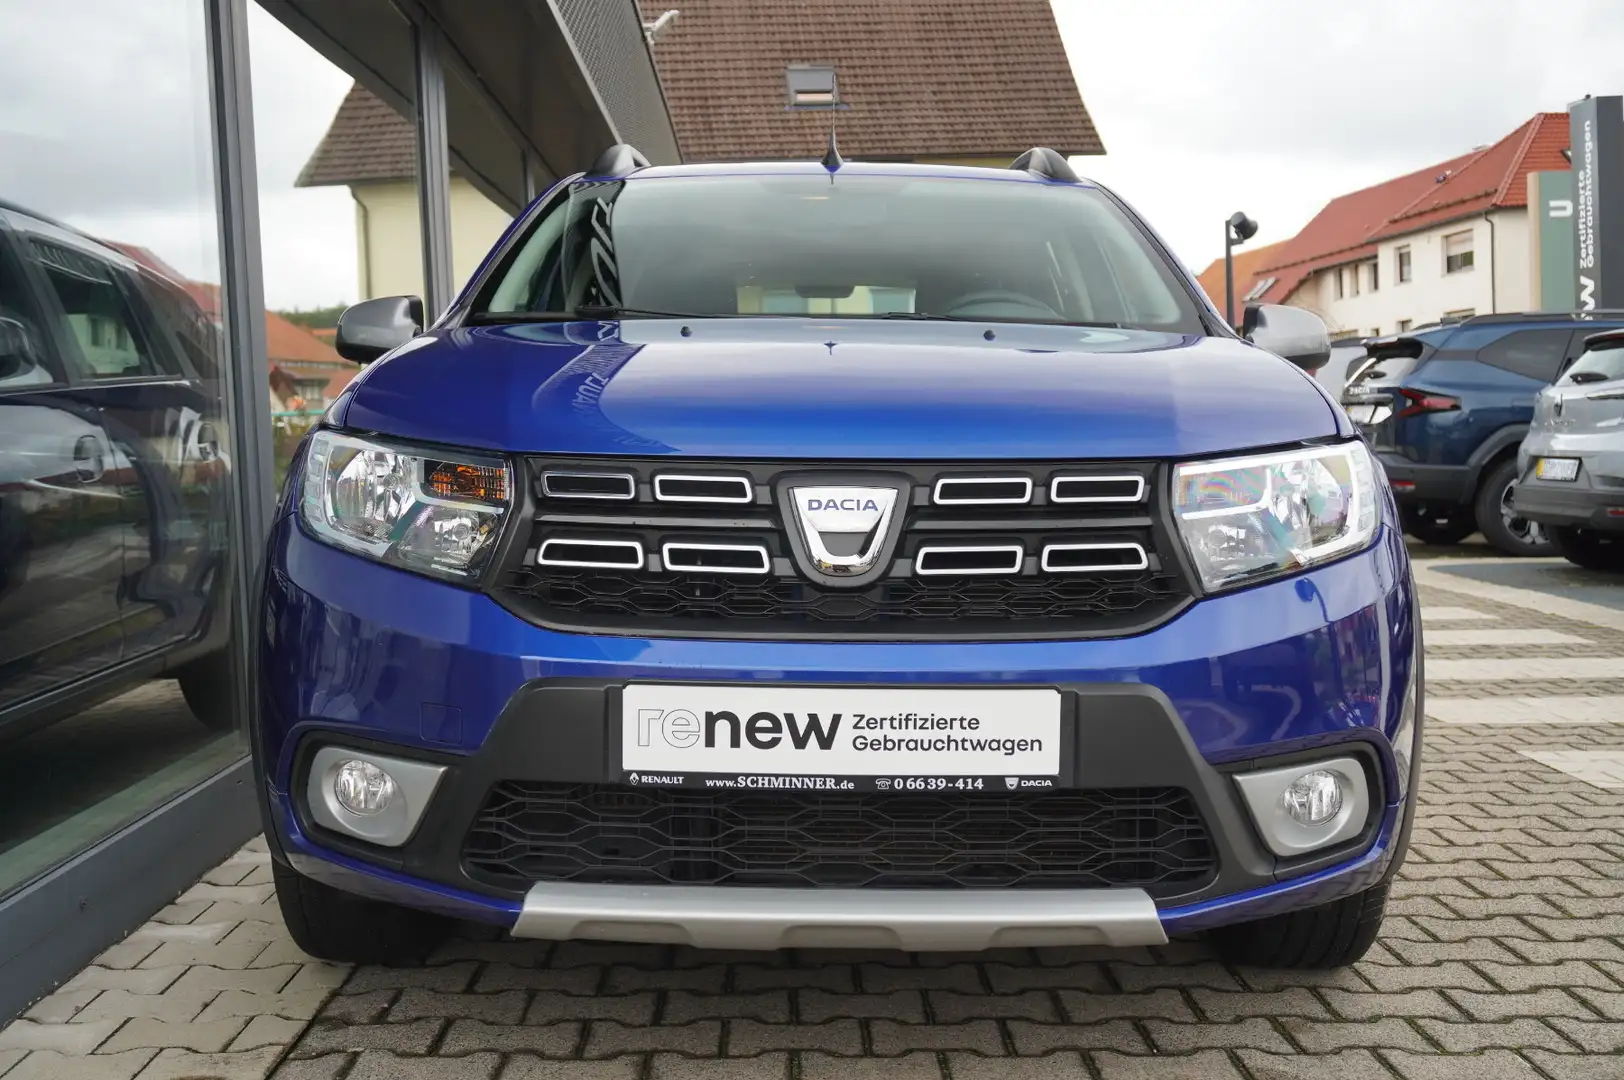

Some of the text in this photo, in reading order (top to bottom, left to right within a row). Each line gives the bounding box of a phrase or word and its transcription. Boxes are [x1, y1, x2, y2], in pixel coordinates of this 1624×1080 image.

[1584, 120, 1594, 268] Gebrauchtwagen
[1578, 170, 1587, 269] Zertifizierte
[807, 499, 878, 511] DACIA
[637, 708, 842, 751] renew
[852, 713, 980, 730] Zertifizierte
[852, 734, 1042, 756] Gebrauchtwagen
[641, 775, 684, 785] RENAULT
[705, 776, 855, 789] www.SCHMINNER.de
